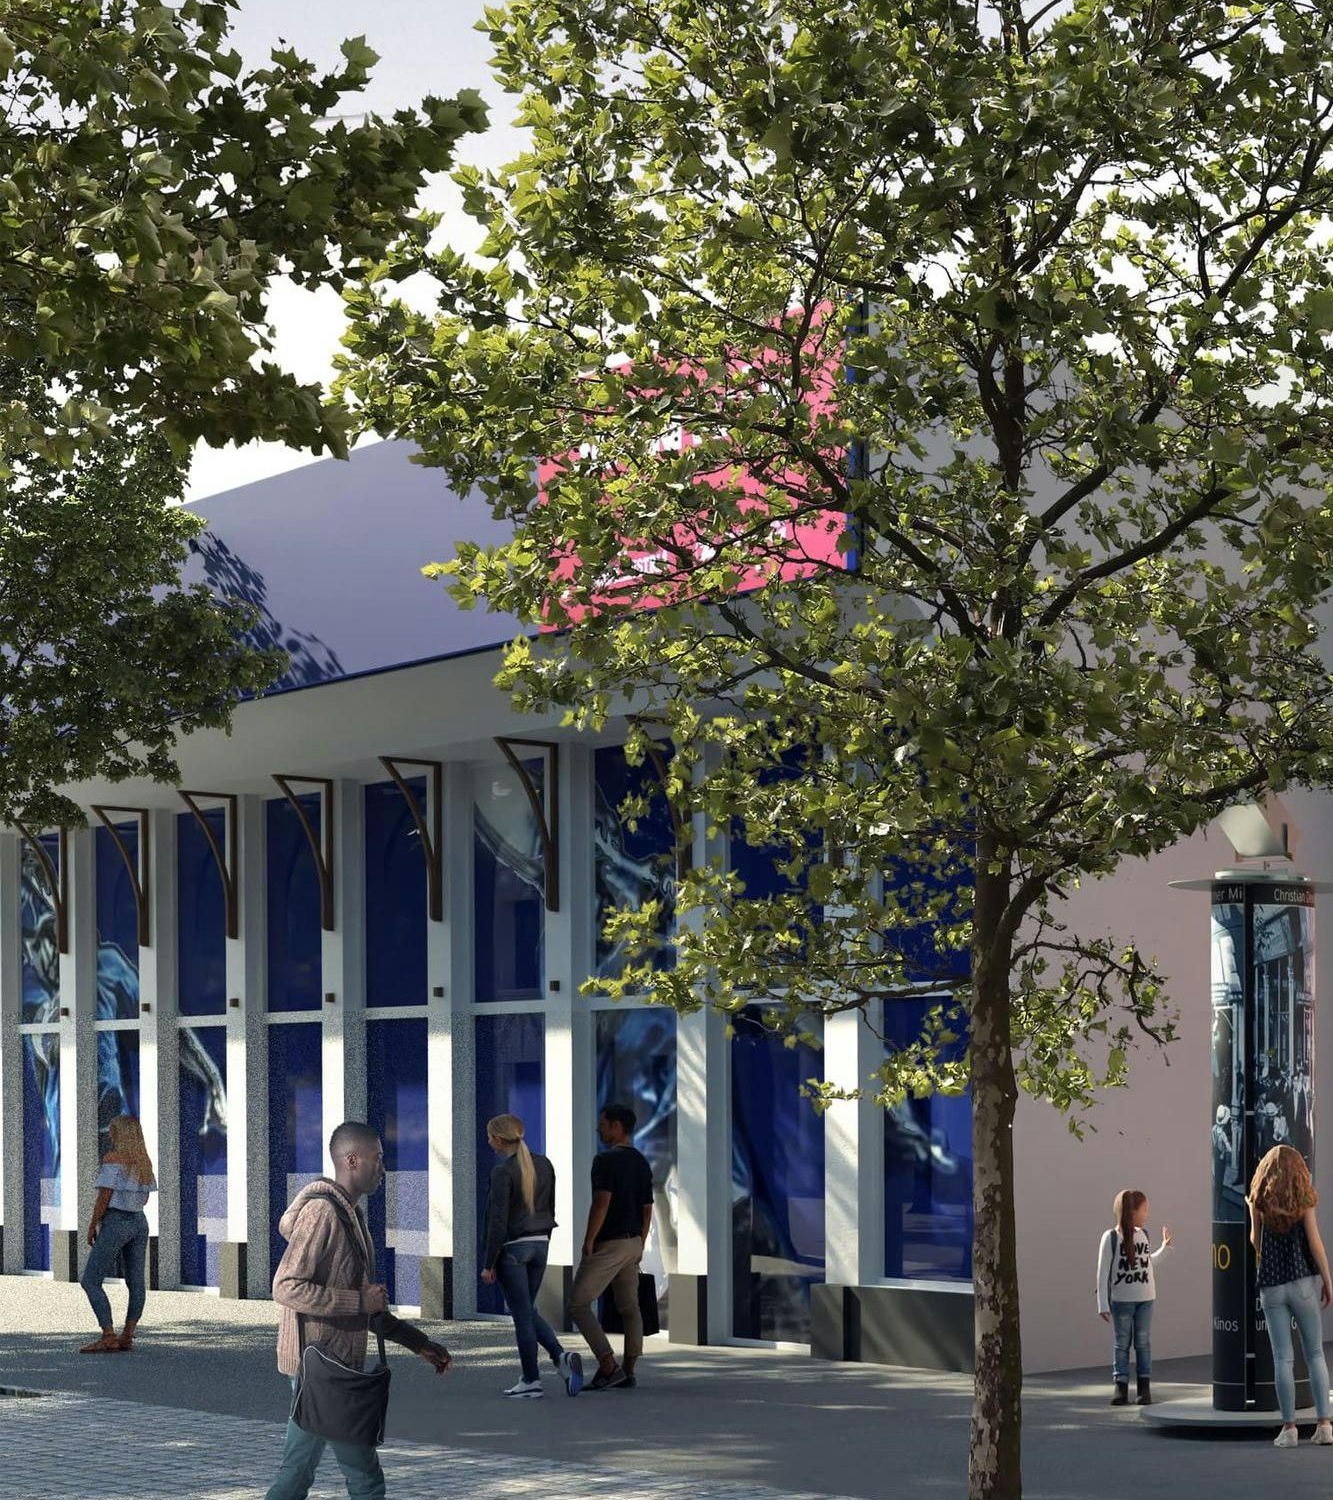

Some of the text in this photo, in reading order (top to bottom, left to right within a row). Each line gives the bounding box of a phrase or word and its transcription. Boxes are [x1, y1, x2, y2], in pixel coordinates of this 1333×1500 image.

[1273, 887, 1306, 903] Christian
[1118, 1257, 1149, 1272] NEW
[1114, 1271, 1149, 1285] YORK
